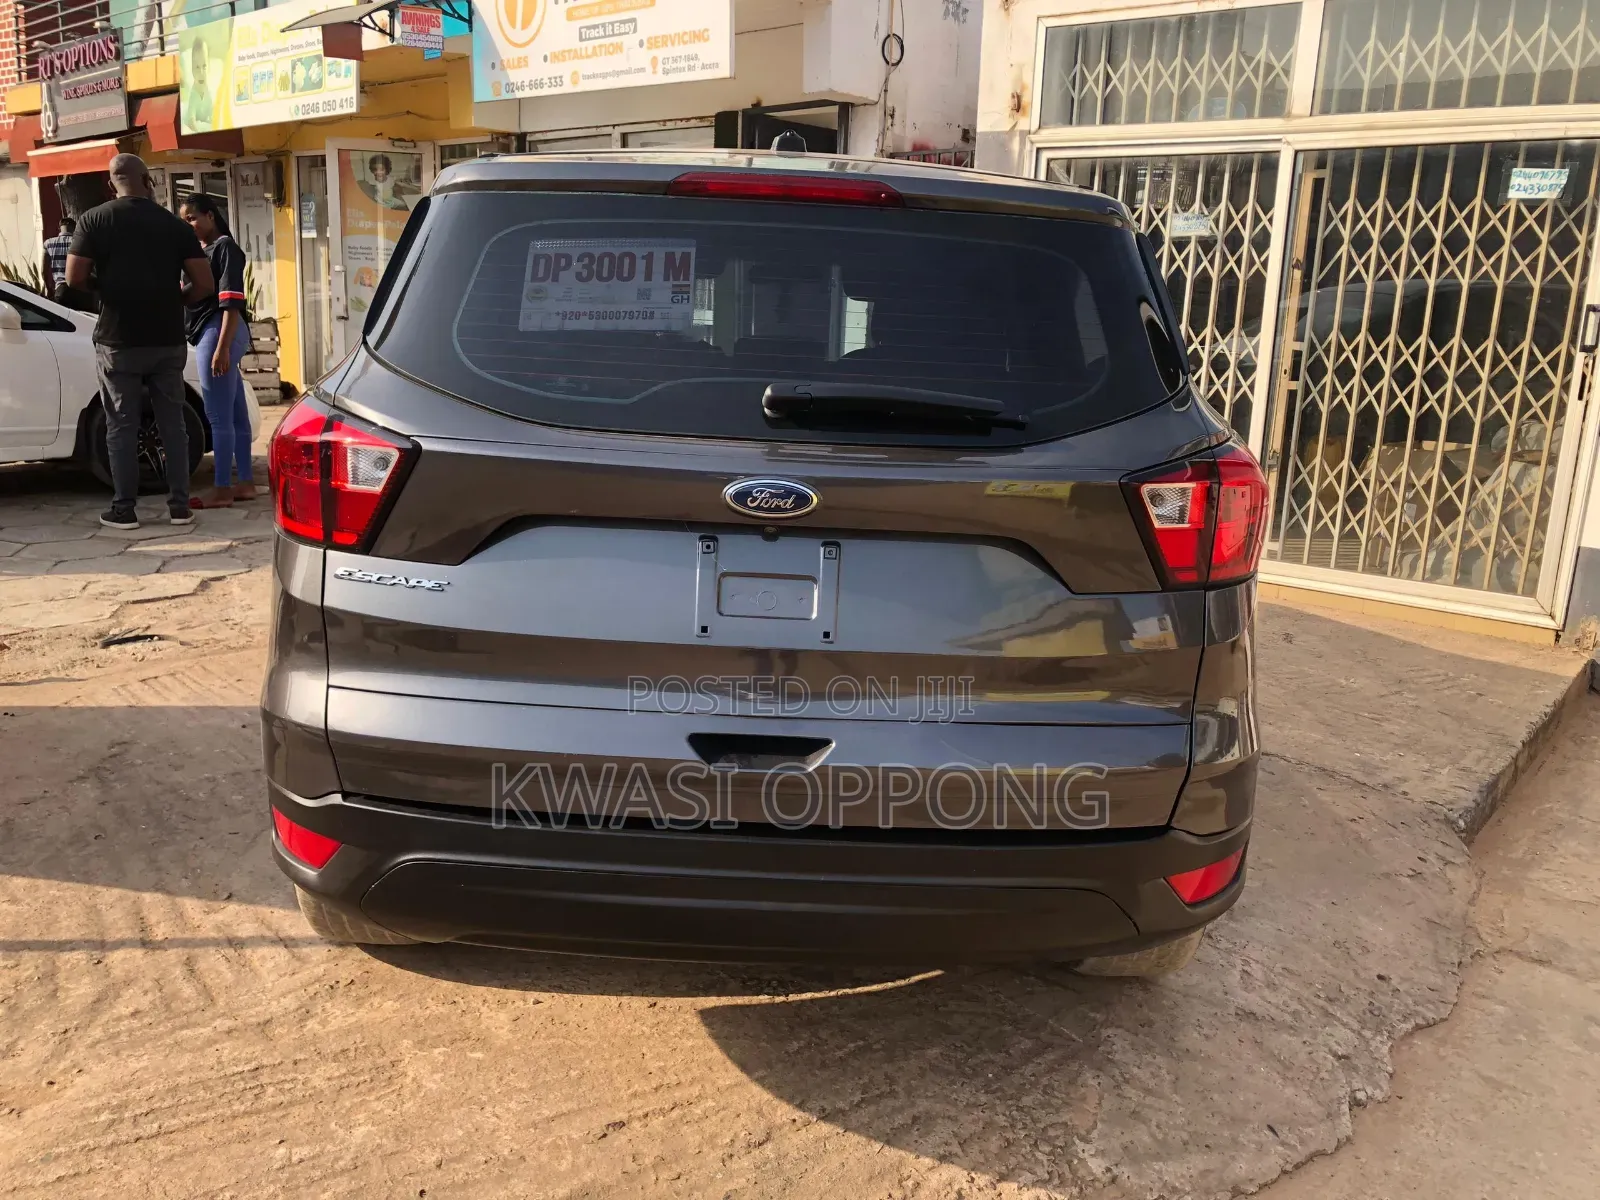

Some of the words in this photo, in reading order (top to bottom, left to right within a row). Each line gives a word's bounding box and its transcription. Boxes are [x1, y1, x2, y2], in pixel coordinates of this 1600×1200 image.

[402, 11, 441, 28] AWNINGS
[417, 26, 430, 34] SALE
[580, 27, 604, 39] Track
[605, 23, 612, 36] it
[614, 20, 636, 35] Easy
[62, 35, 116, 72] OPTIONS
[500, 56, 529, 71] SALES
[549, 42, 624, 64] INSTALLATION
[646, 28, 711, 50] SERVICING
[662, 57, 670, 66] GT
[687, 63, 696, 72] Rd
[701, 62, 719, 71] Accra
[101, 76, 120, 91] MORE
[505, 75, 564, 93] 0246-666-333
[301, 102, 320, 116] 0246
[322, 99, 337, 113] 050
[339, 96, 354, 109] 416
[531, 252, 573, 283] DP
[575, 251, 654, 283] 3001
[663, 251, 692, 282] M
[670, 294, 690, 304] GH
[747, 487, 797, 509] Ford
[334, 566, 451, 592] ESCAPE
